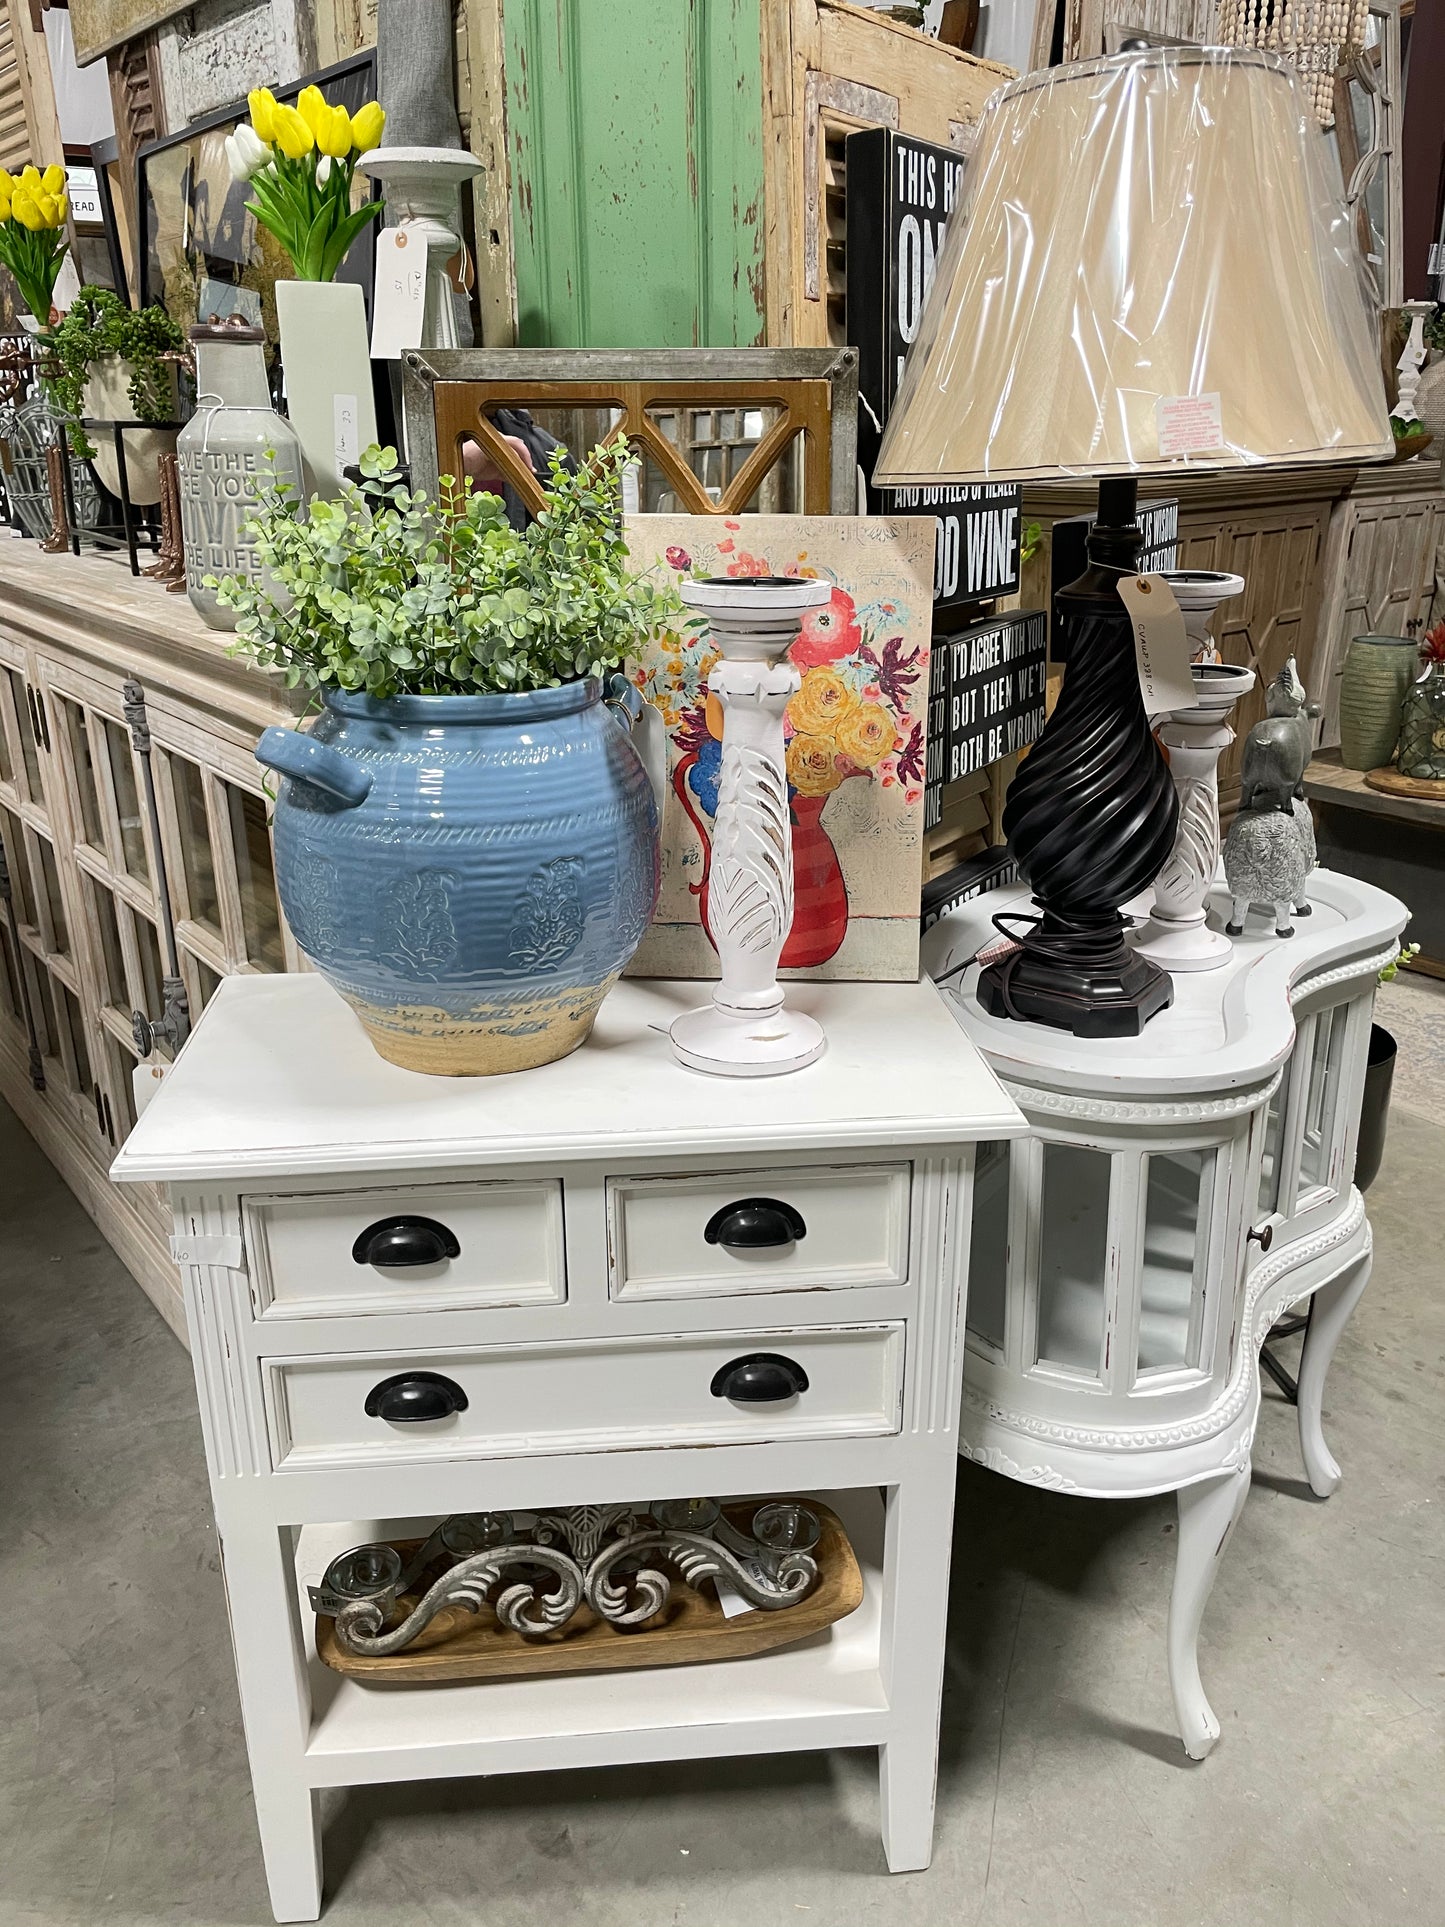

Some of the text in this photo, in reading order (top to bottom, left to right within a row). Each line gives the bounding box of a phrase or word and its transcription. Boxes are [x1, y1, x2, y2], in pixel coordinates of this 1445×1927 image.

[897, 146, 936, 209] THIS
[206, 452, 256, 472] THE
[208, 475, 258, 497] YOU
[893, 488, 920, 508] AND
[1145, 512, 1153, 549] IS
[1153, 505, 1179, 546] WISDOM
[210, 548, 262, 569] LIFE
[966, 507, 1018, 593] WINE
[952, 643, 968, 682] I'D
[969, 630, 1001, 676] AGREE
[1002, 622, 1025, 664] WITH
[935, 698, 945, 735] TO
[952, 661, 1046, 732] BUT THEN WE'D
[951, 705, 1045, 780] BOTH BE WRONG
